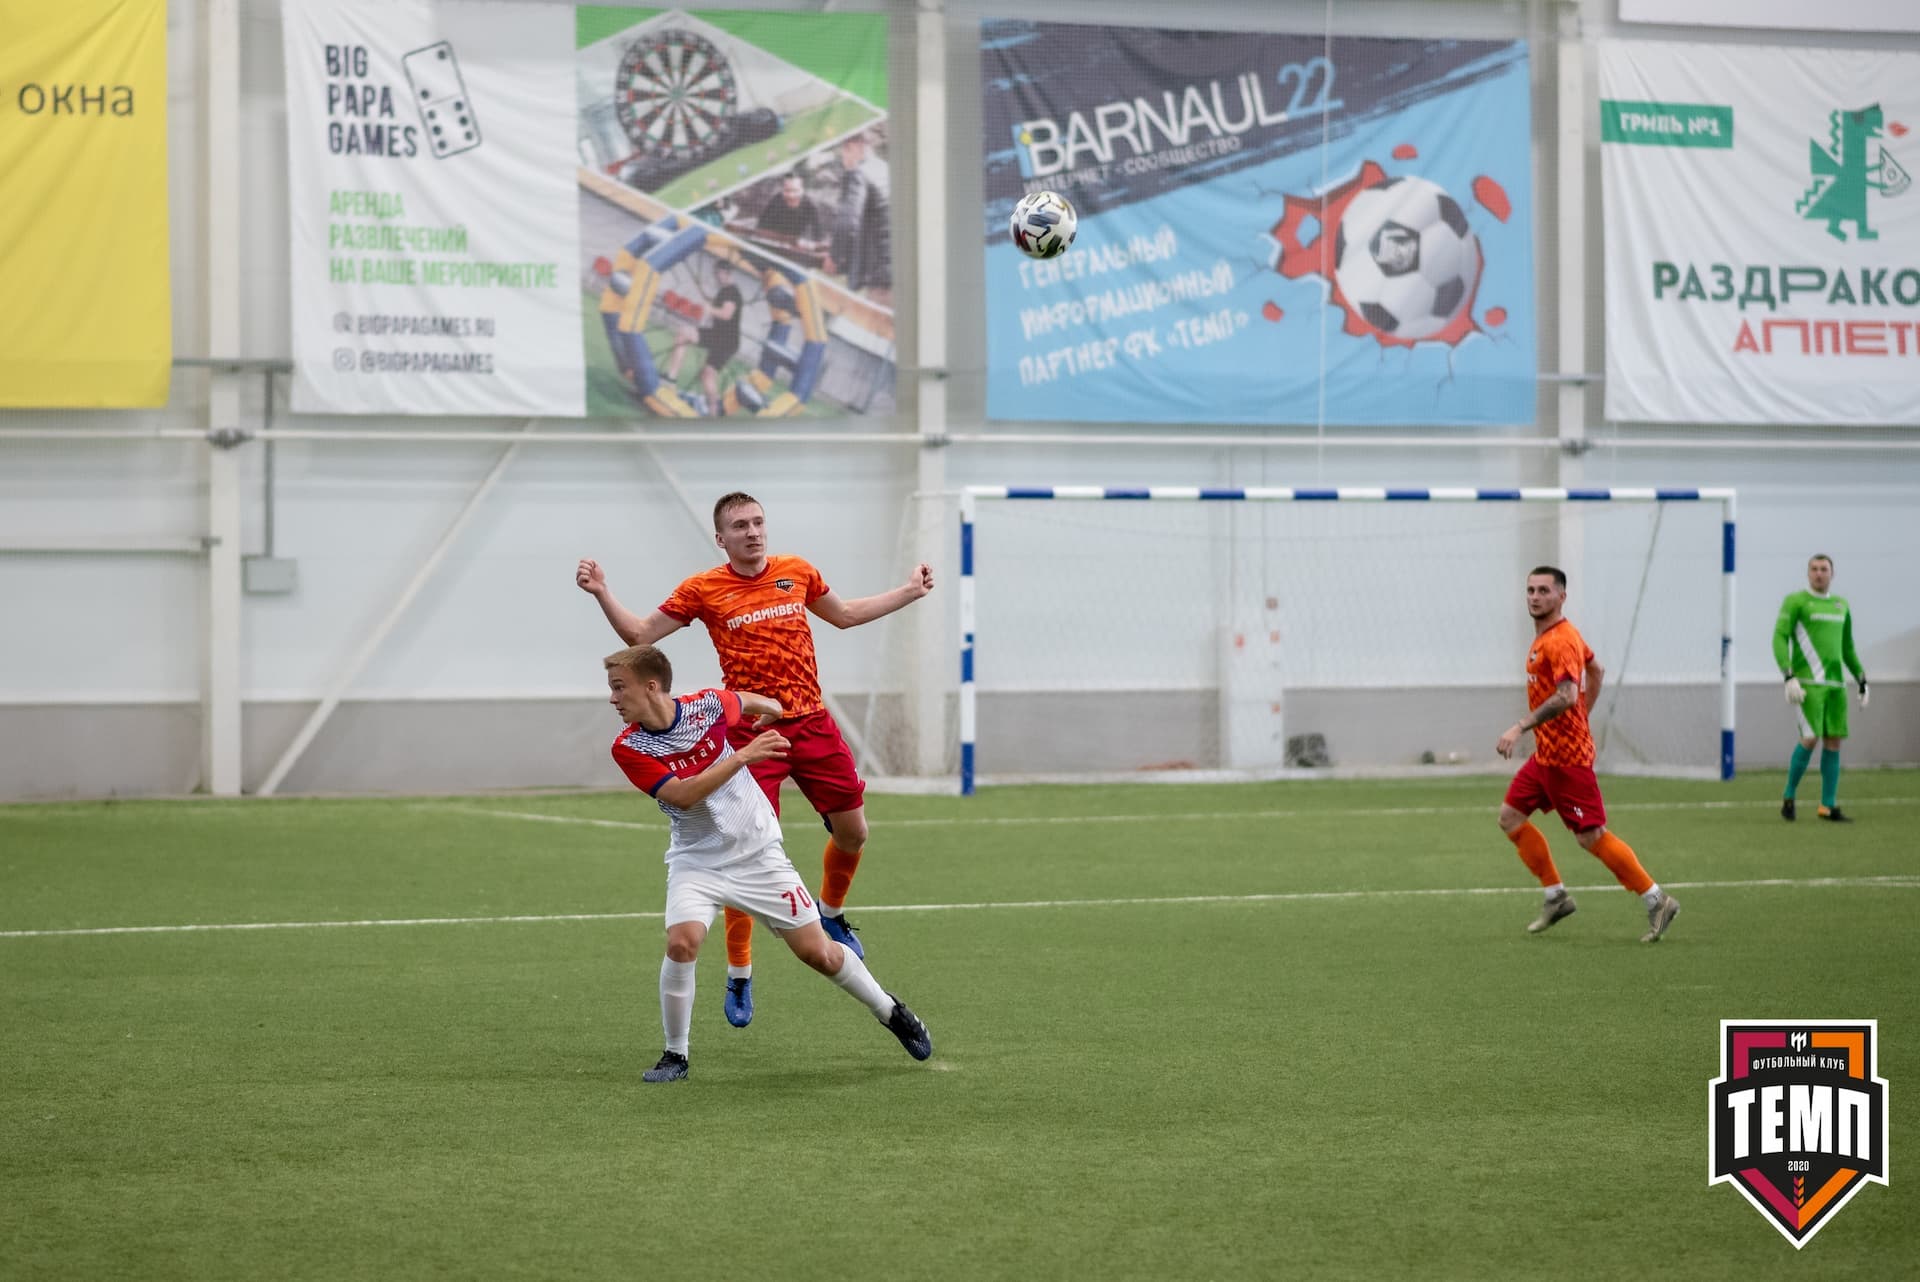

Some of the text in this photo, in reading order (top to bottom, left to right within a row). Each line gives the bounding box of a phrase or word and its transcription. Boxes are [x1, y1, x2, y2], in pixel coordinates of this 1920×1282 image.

[325, 43, 369, 79] BIG
[17, 82, 135, 117] окна
[327, 82, 395, 119] PAPA
[327, 120, 418, 158] GAMES
[1687, 115, 1721, 137] №1
[328, 190, 405, 220] АРЕНДА
[328, 223, 469, 254] РАЗВЛЕЧЕНИЙ
[328, 256, 558, 289] НА ВАШЕ МЕРОПРИЯТИЕ
[1018, 225, 1177, 289] ГЕНЕРАЛЬНЫЙ
[1019, 256, 1236, 342] ИНФОРМАЦИОННЫЙ
[357, 314, 496, 338] BIGPAPAGAMES.RU
[1732, 317, 1920, 357] АППЕТ
[359, 350, 495, 376] @BIGPAPAGAMES
[1018, 336, 1119, 387] ПАРТНЕР
[1123, 326, 1163, 361] ФК
[781, 885, 812, 917] 70
